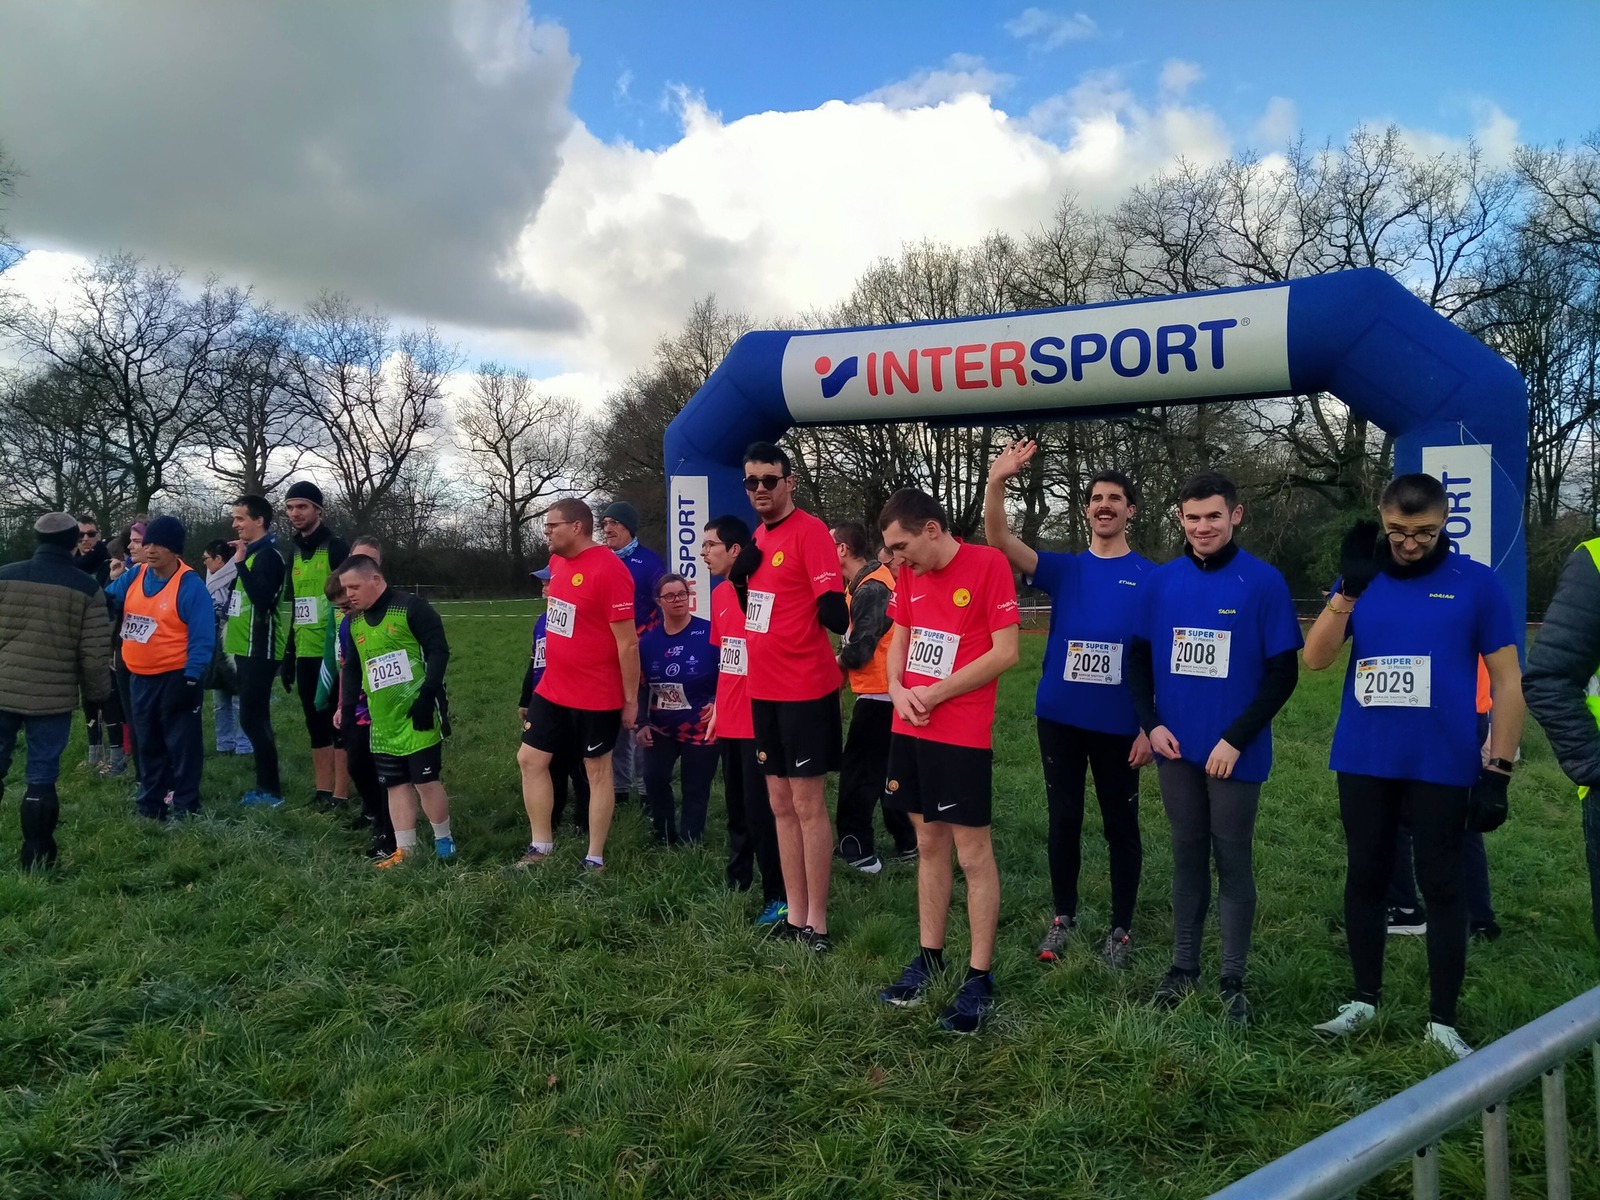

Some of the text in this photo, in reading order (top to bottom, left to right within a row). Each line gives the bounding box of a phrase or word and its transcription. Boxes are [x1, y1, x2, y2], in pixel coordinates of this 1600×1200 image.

[866, 318, 1237, 397] INTERSPORT
[547, 607, 567, 628] 2040
[923, 630, 945, 640] SUPER
[1188, 629, 1215, 639] SUPER
[911, 640, 943, 665] 2009
[1085, 642, 1110, 650] SUPER
[1176, 641, 1216, 665] 2008
[378, 653, 396, 662] SUPER
[722, 647, 741, 666] 2018
[1073, 653, 1110, 673] 2028
[372, 661, 402, 682] 2025
[1365, 671, 1414, 693] 2029
